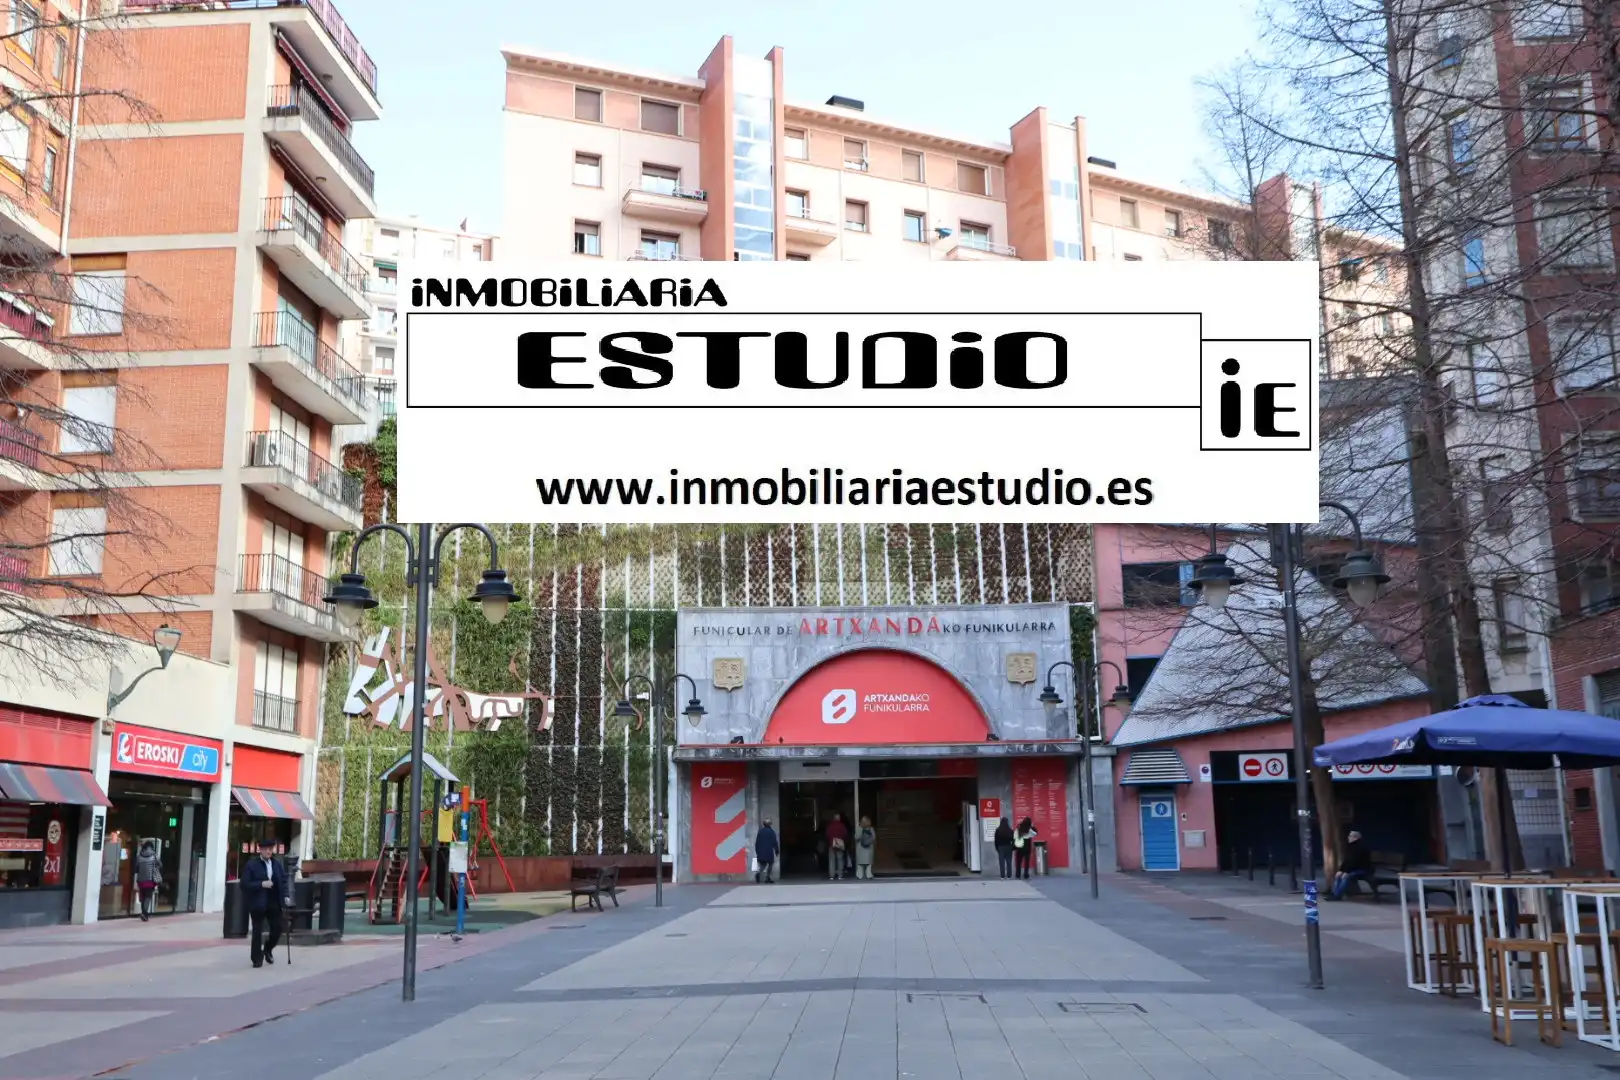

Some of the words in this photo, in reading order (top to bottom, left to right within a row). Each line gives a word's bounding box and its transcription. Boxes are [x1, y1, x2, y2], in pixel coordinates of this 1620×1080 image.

[693, 625, 772, 636] FUNICULAR
[776, 625, 793, 636] DE
[965, 621, 1056, 633] FUNIKULARRA
[863, 693, 930, 703] ARTXANDAKO
[863, 703, 930, 713] FUNIKULARRA
[137, 741, 179, 764] EROSKI
[43, 855, 61, 873] 2x1
